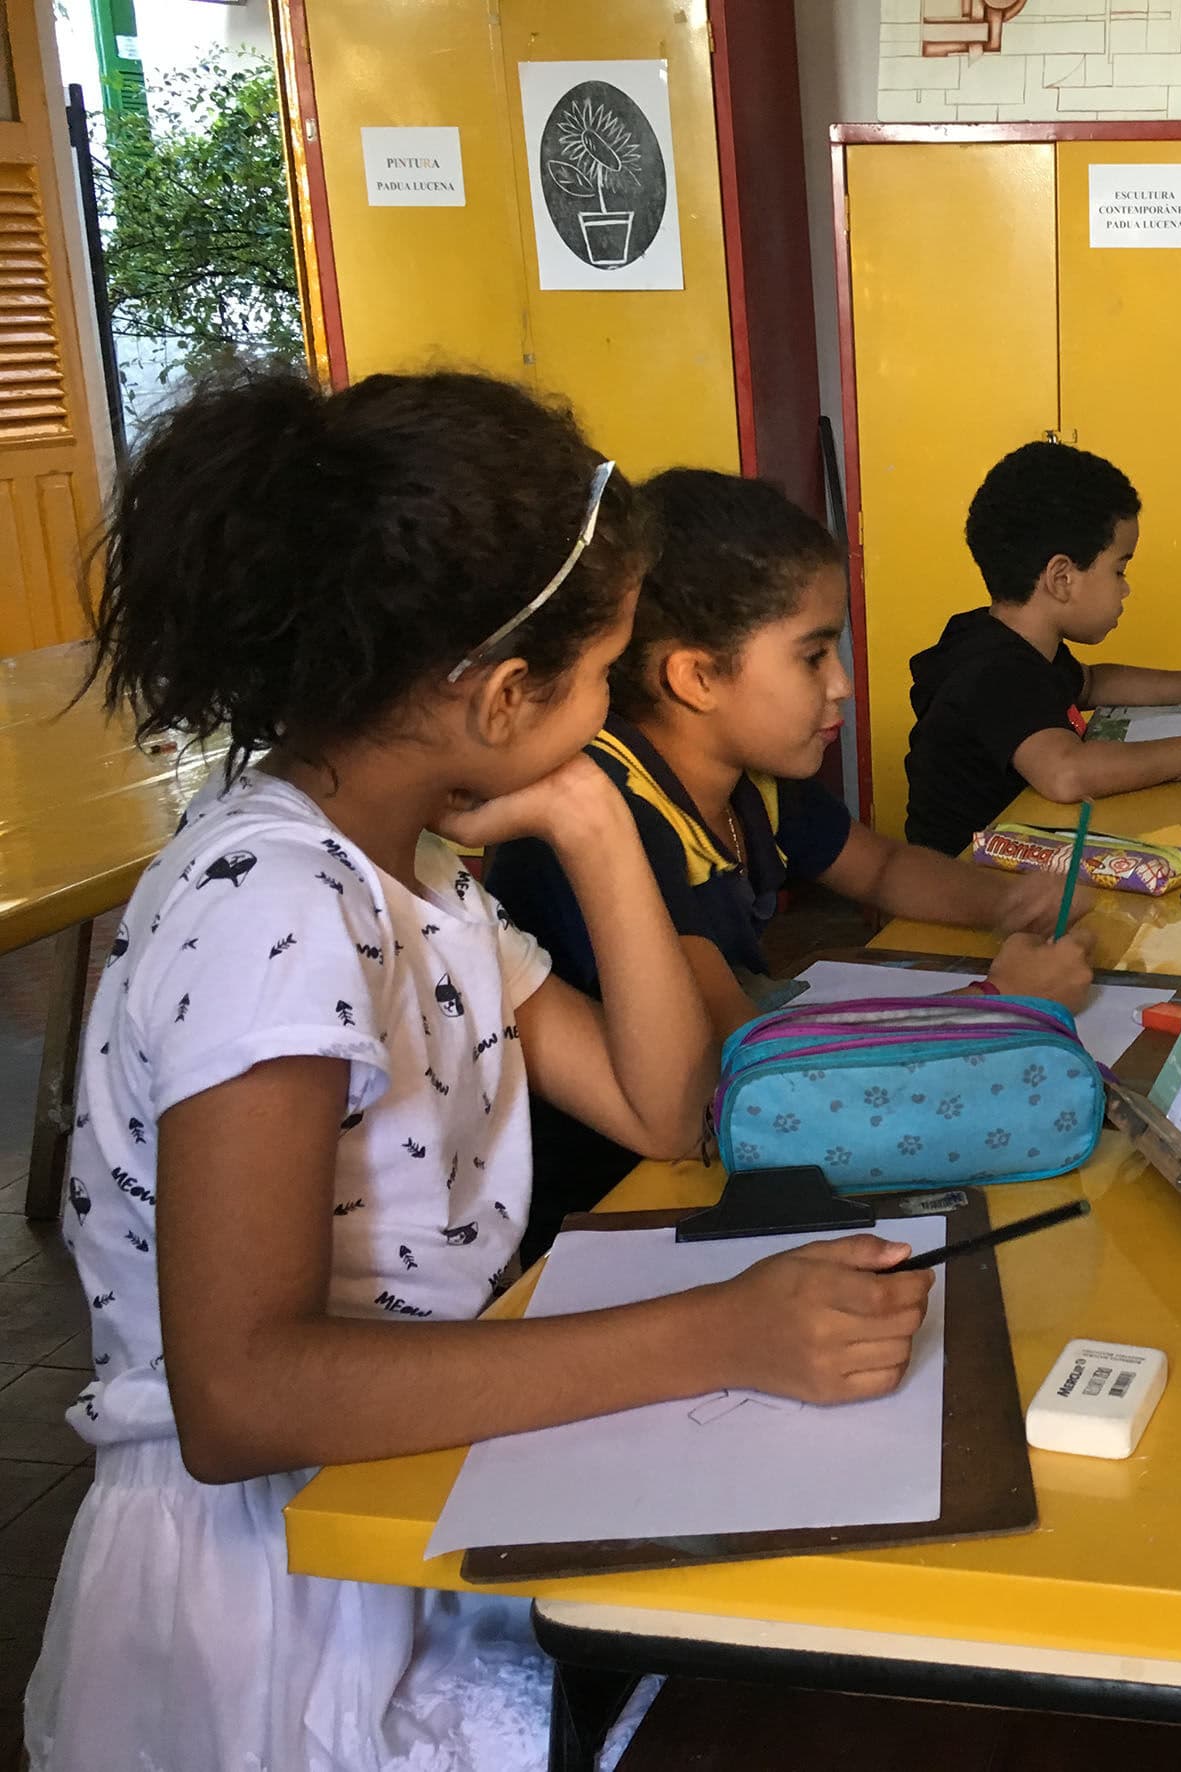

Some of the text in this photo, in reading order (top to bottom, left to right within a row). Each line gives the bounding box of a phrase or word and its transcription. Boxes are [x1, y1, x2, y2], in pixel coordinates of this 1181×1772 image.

[386, 158, 440, 169] PINTURA
[376, 181, 455, 191] PADUA LUCENA
[1114, 191, 1175, 200] ESCULTURA
[1106, 220, 1140, 229] PADUA
[111, 1167, 156, 1206] MEOW
[374, 1291, 432, 1317] MEOW
